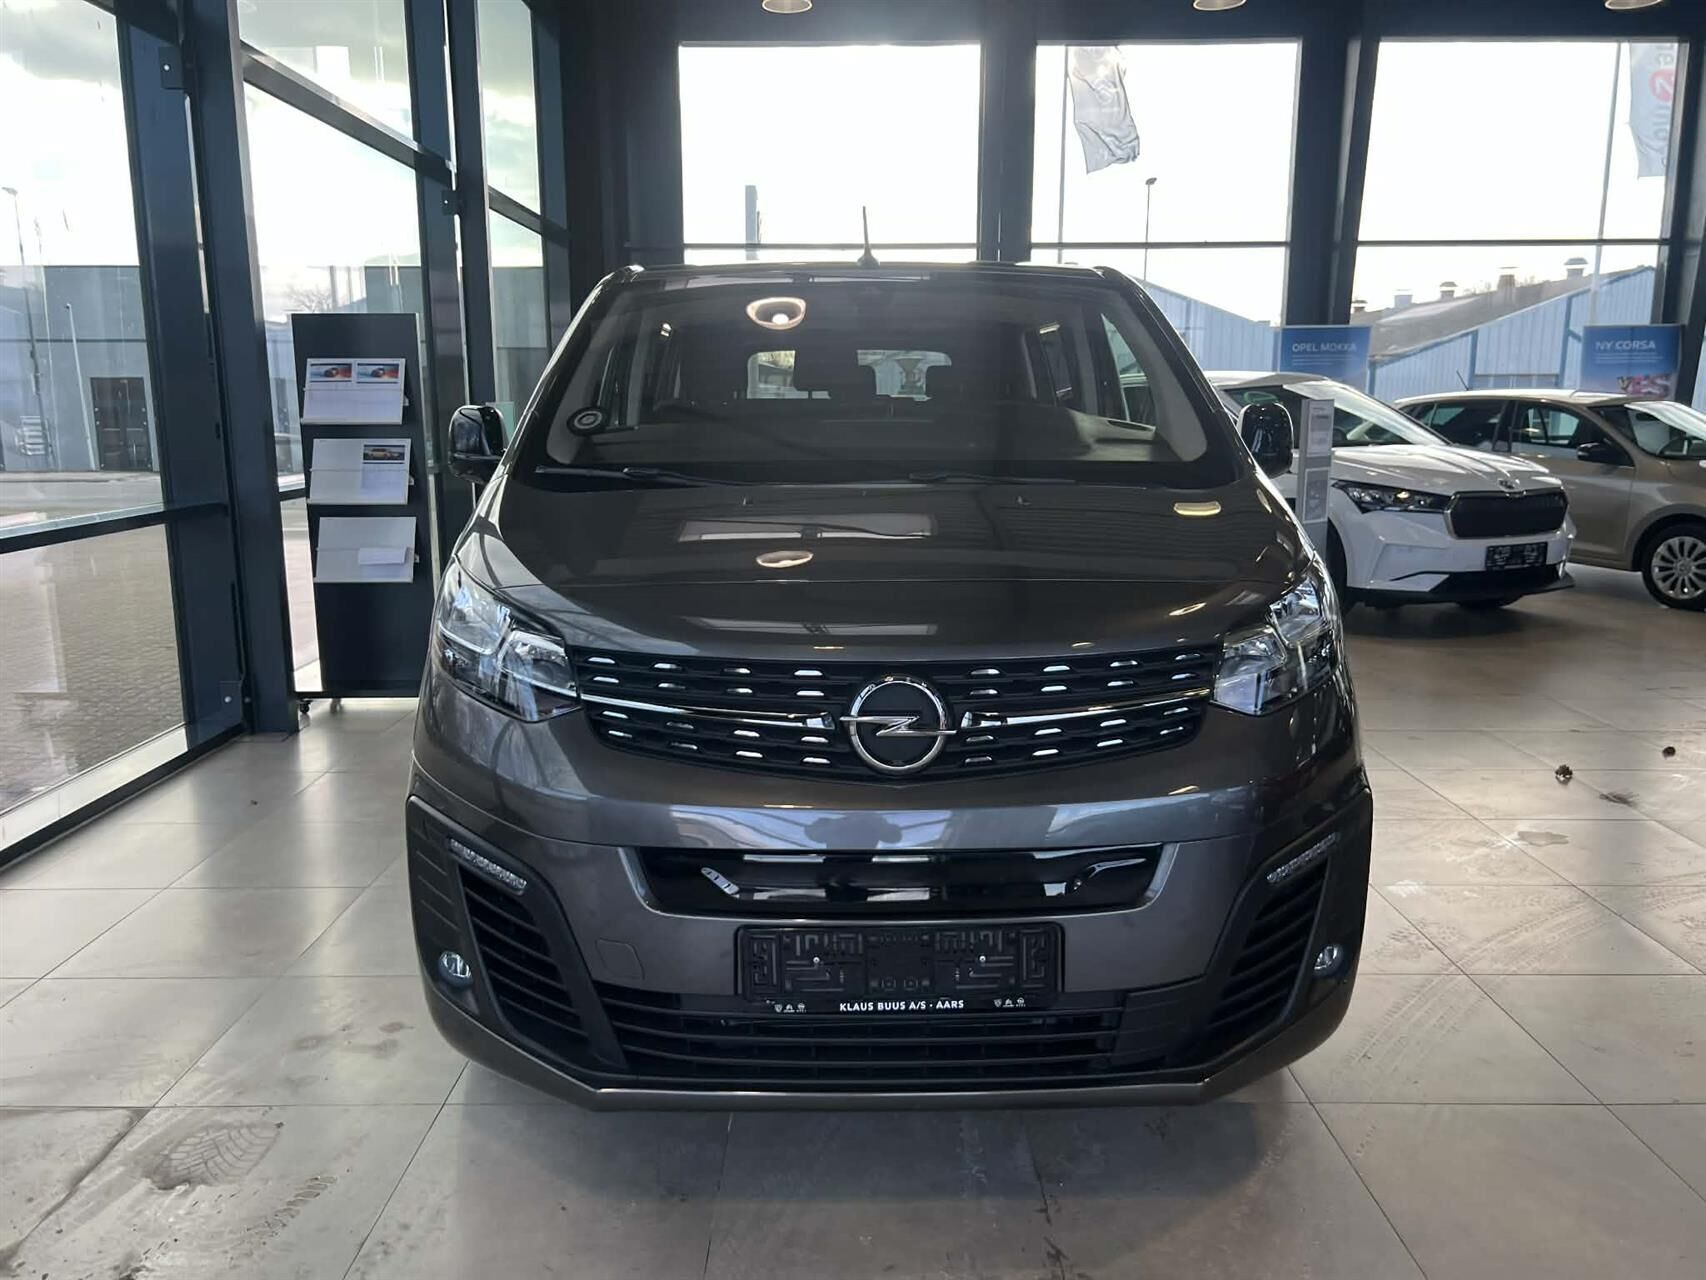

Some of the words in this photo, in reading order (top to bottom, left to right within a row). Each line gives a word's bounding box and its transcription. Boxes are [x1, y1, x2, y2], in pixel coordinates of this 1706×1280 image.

[1292, 343, 1319, 352] OPEL
[1615, 340, 1656, 350] CORSA
[839, 1002, 874, 1011] KLAUS
[877, 1001, 906, 1011] BUUS
[908, 1001, 926, 1010] A/S
[936, 1000, 964, 1009] AARS
